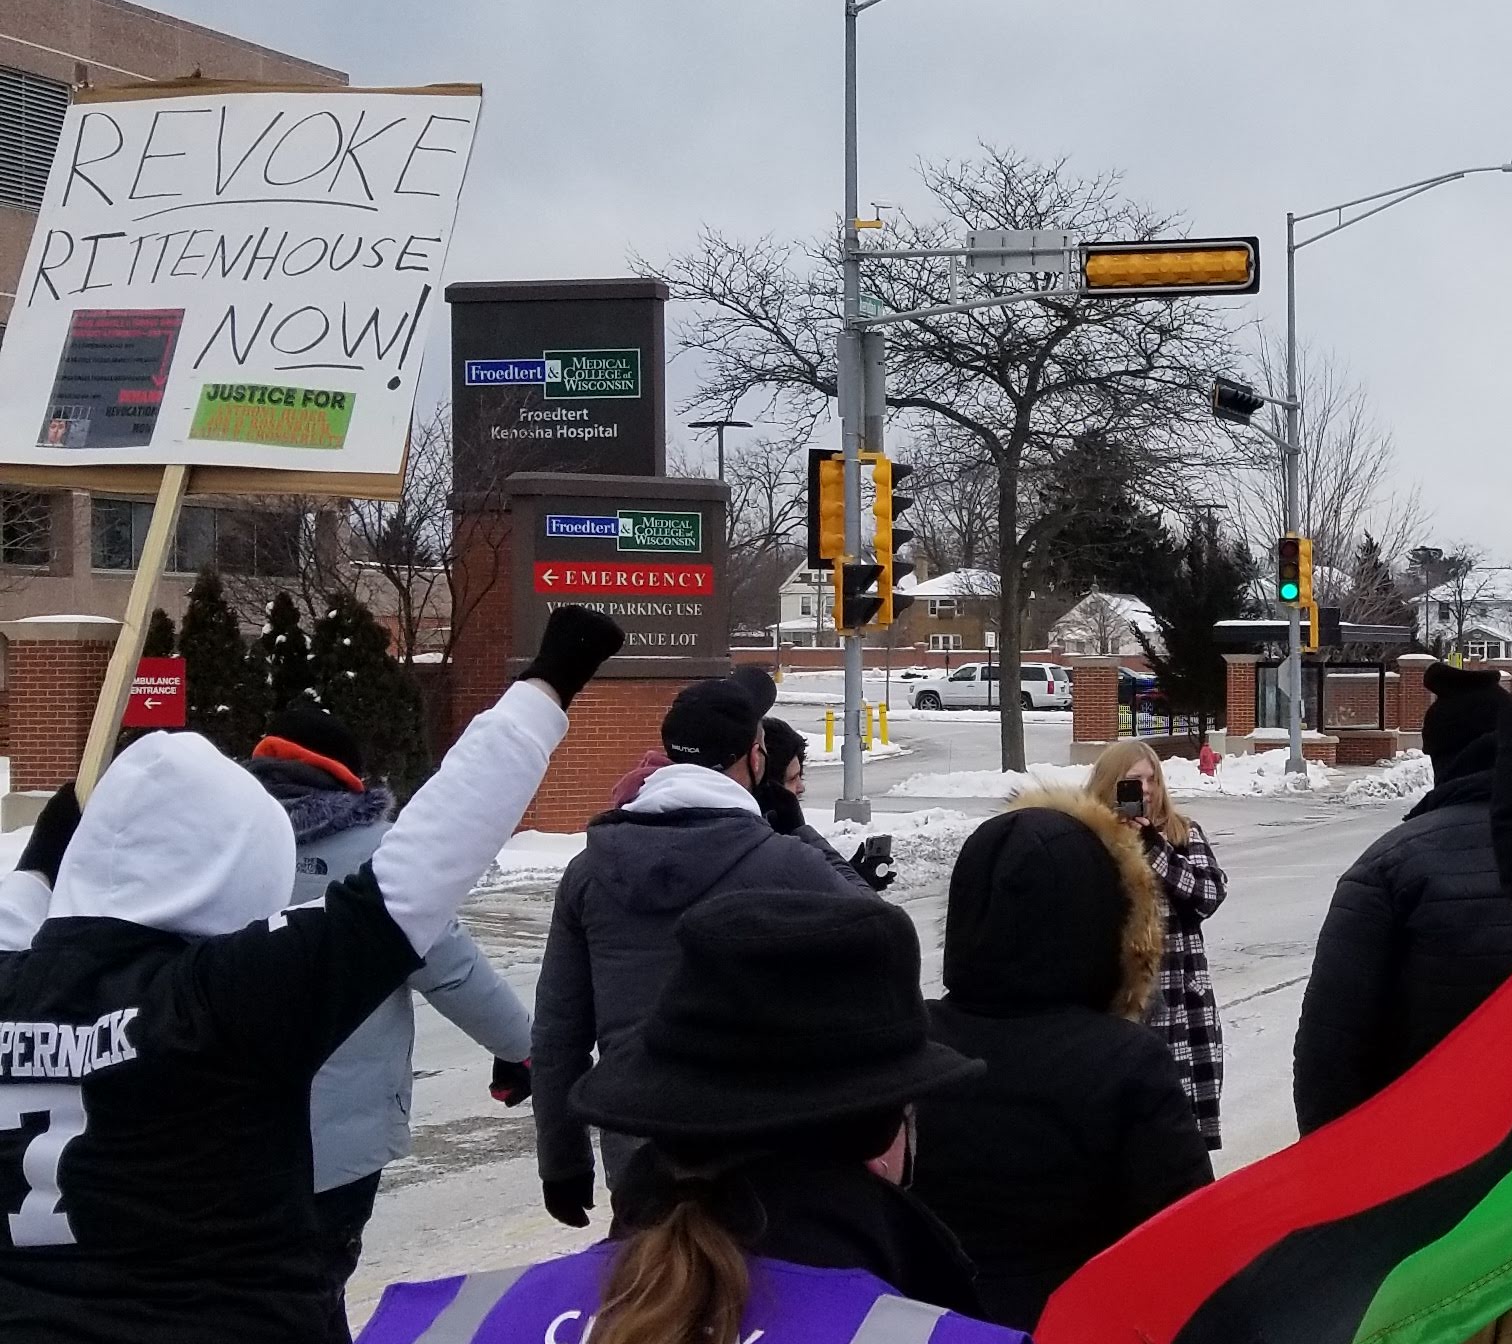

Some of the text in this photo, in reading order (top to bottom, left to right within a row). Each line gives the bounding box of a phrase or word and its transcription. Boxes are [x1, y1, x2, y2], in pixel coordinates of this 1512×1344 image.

[62, 105, 471, 207] REVOKE
[28, 227, 442, 307] RITTENHOUSE
[194, 283, 432, 391] NOW!
[572, 357, 630, 370] MEDICAL
[471, 364, 560, 381] Froedtert &
[563, 367, 634, 381] COLLEGE of
[563, 379, 634, 392] WISCONSIN
[206, 383, 346, 410] JUSTICE FOR
[519, 407, 589, 422] Froedtert
[491, 423, 618, 441] Kenosha Hospital
[551, 519, 632, 535] Froedtert &
[641, 516, 692, 529] MEDICAL
[634, 524, 685, 538] COLLEGE
[634, 535, 696, 546] WISCONSIN
[564, 570, 706, 587] EMERGENCY
[609, 602, 672, 616] PARKING
[676, 602, 703, 616] USE
[624, 632, 698, 646] ENUE LOT
[132, 676, 181, 685] MBULANCE
[130, 686, 177, 695] ENTRANCE
[0, 1083, 87, 1247] 7
